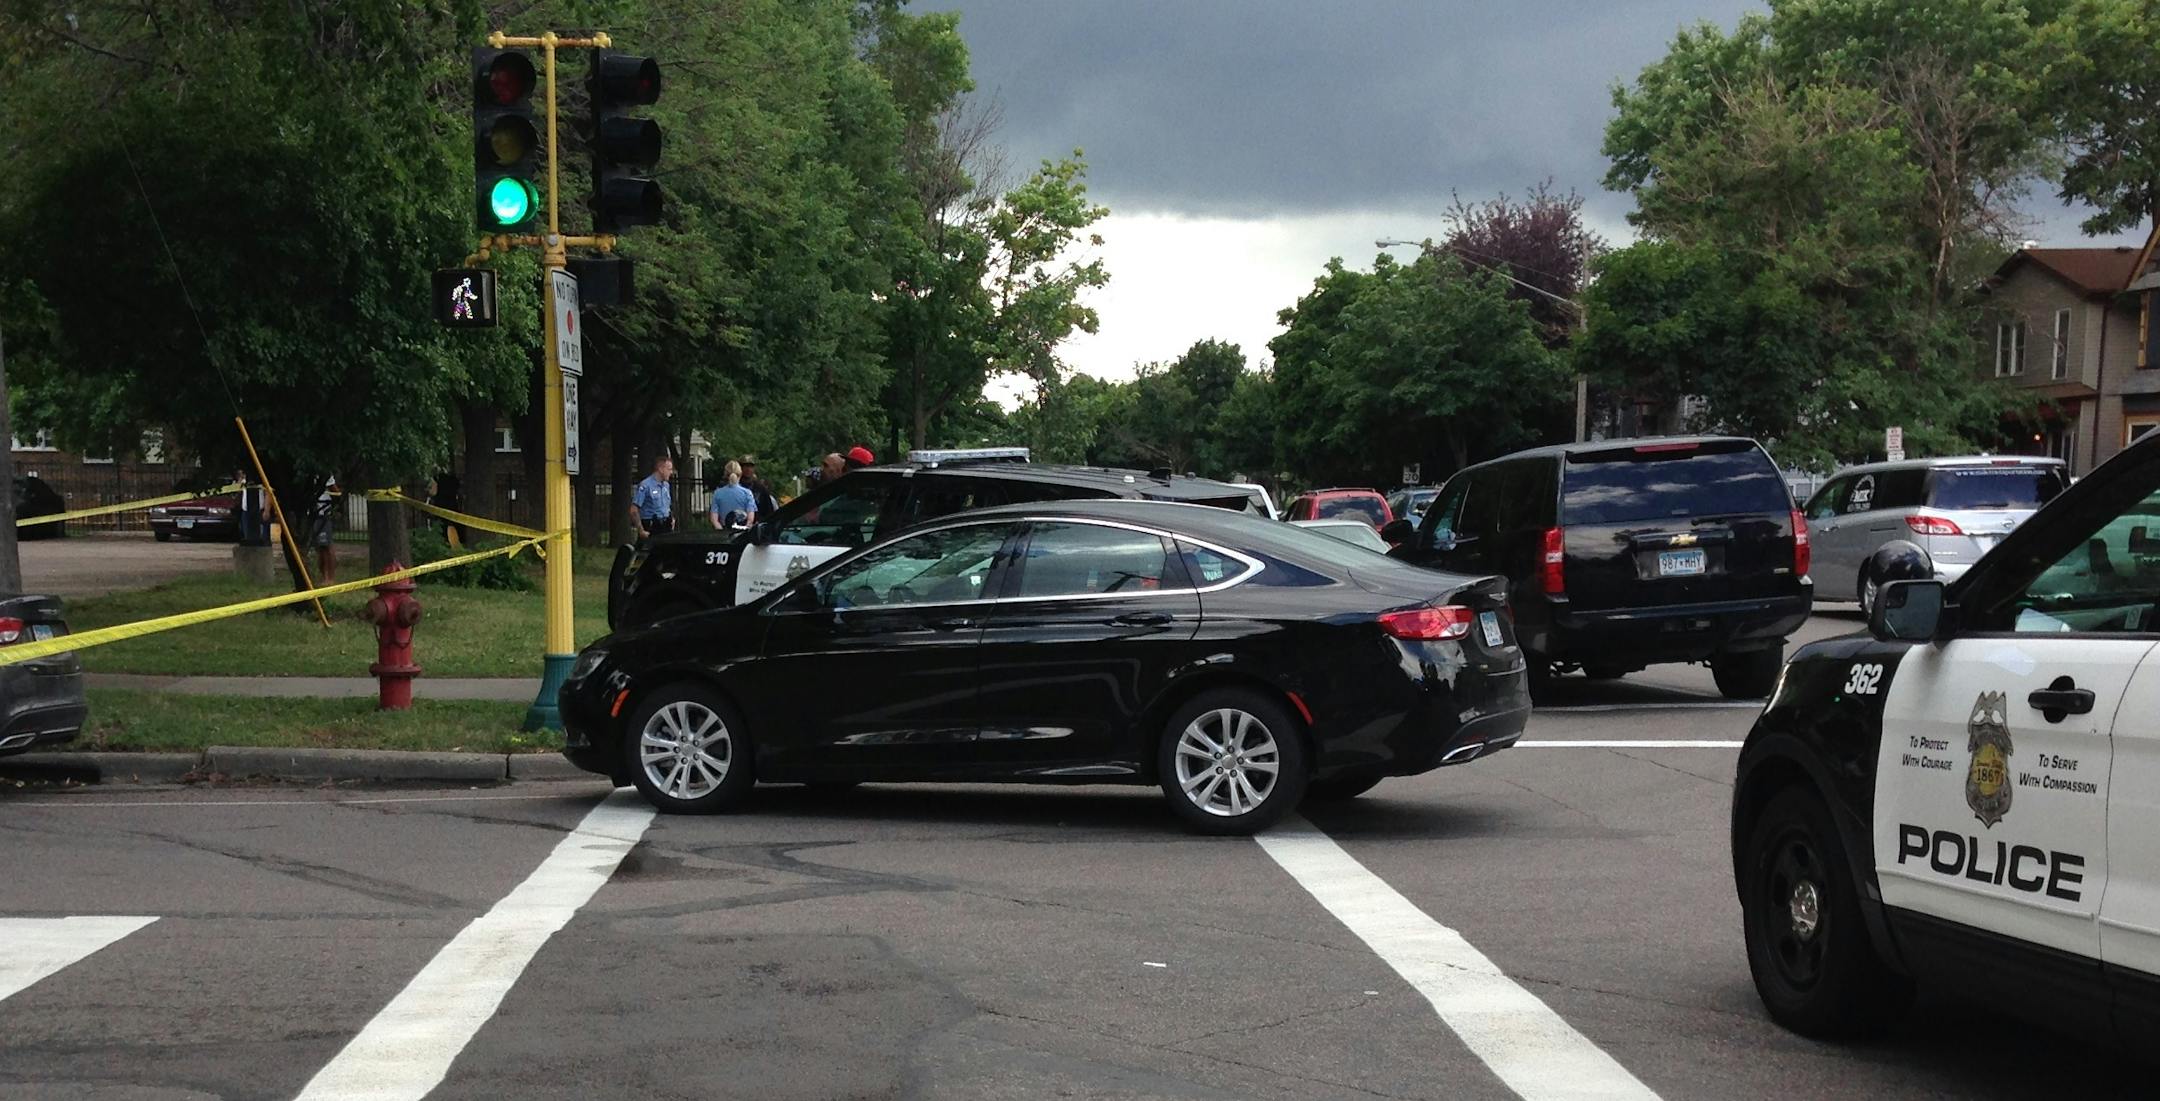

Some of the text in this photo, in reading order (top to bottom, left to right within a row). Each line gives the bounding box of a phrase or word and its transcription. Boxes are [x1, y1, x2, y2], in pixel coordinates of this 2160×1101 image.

[556, 281, 566, 300] NO
[562, 340, 571, 359] ON
[566, 381, 576, 405] ONE
[705, 552, 729, 565] 310
[1844, 663, 1884, 695] 362
[1976, 768, 2001, 784] 1867
[1897, 823, 2085, 903] POLICE
